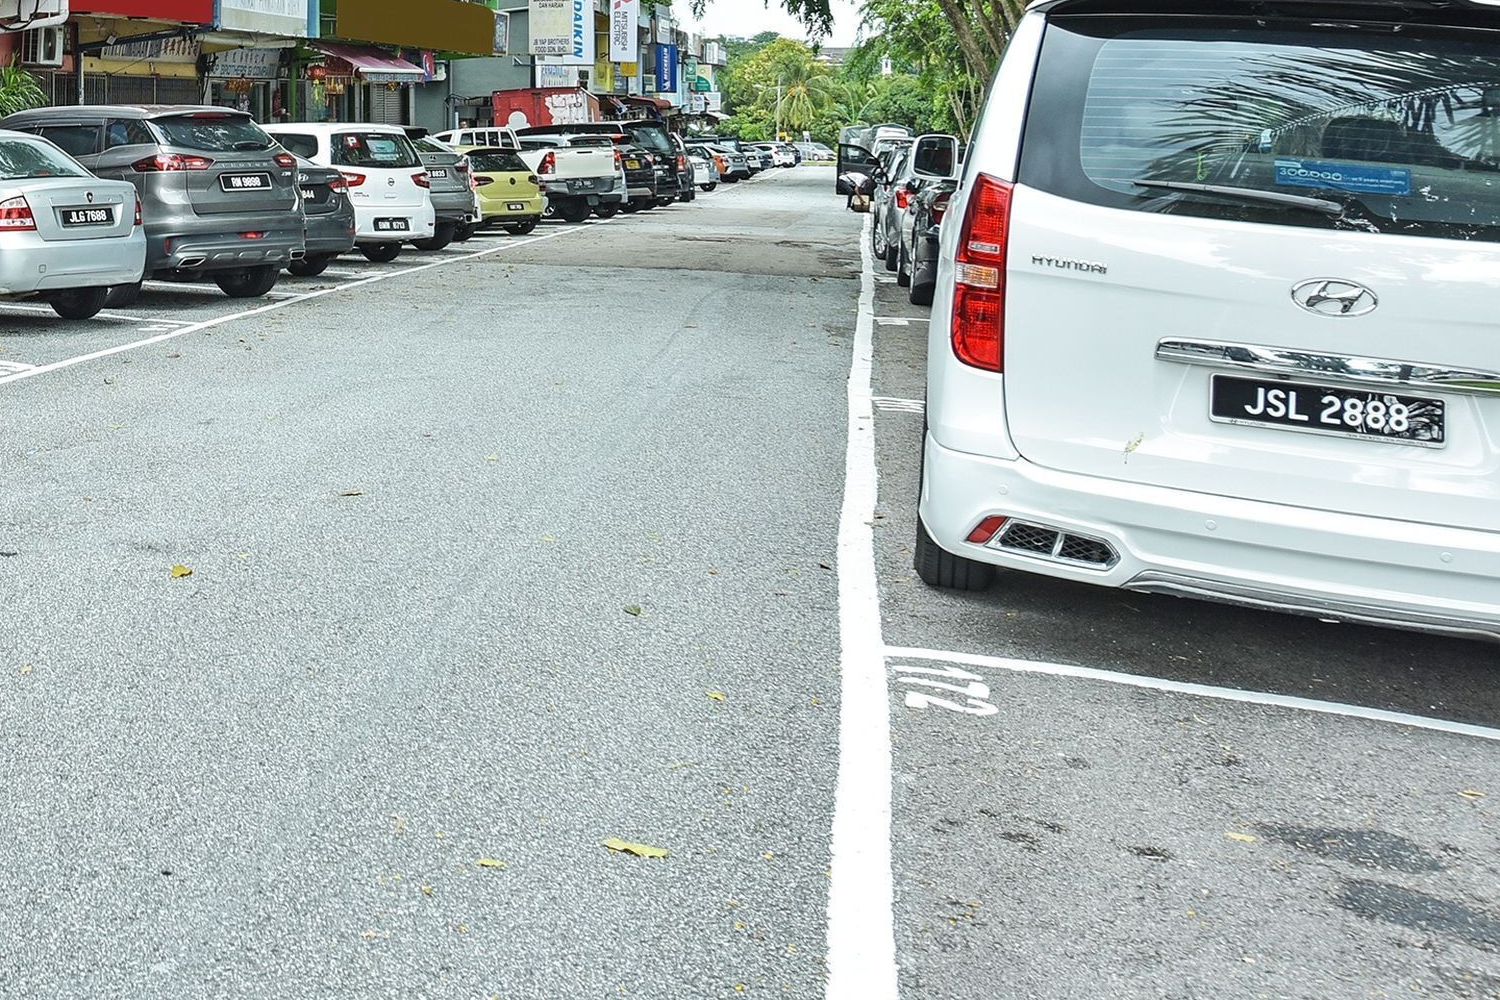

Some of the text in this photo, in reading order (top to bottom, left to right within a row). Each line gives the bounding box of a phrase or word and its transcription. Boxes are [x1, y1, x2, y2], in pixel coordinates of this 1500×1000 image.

[573, 1, 583, 58] DAIKIN
[69, 210, 107, 222] JLG 7688
[1031, 254, 1107, 275] HYUNDAI
[1244, 387, 1409, 432] JSL 2888
